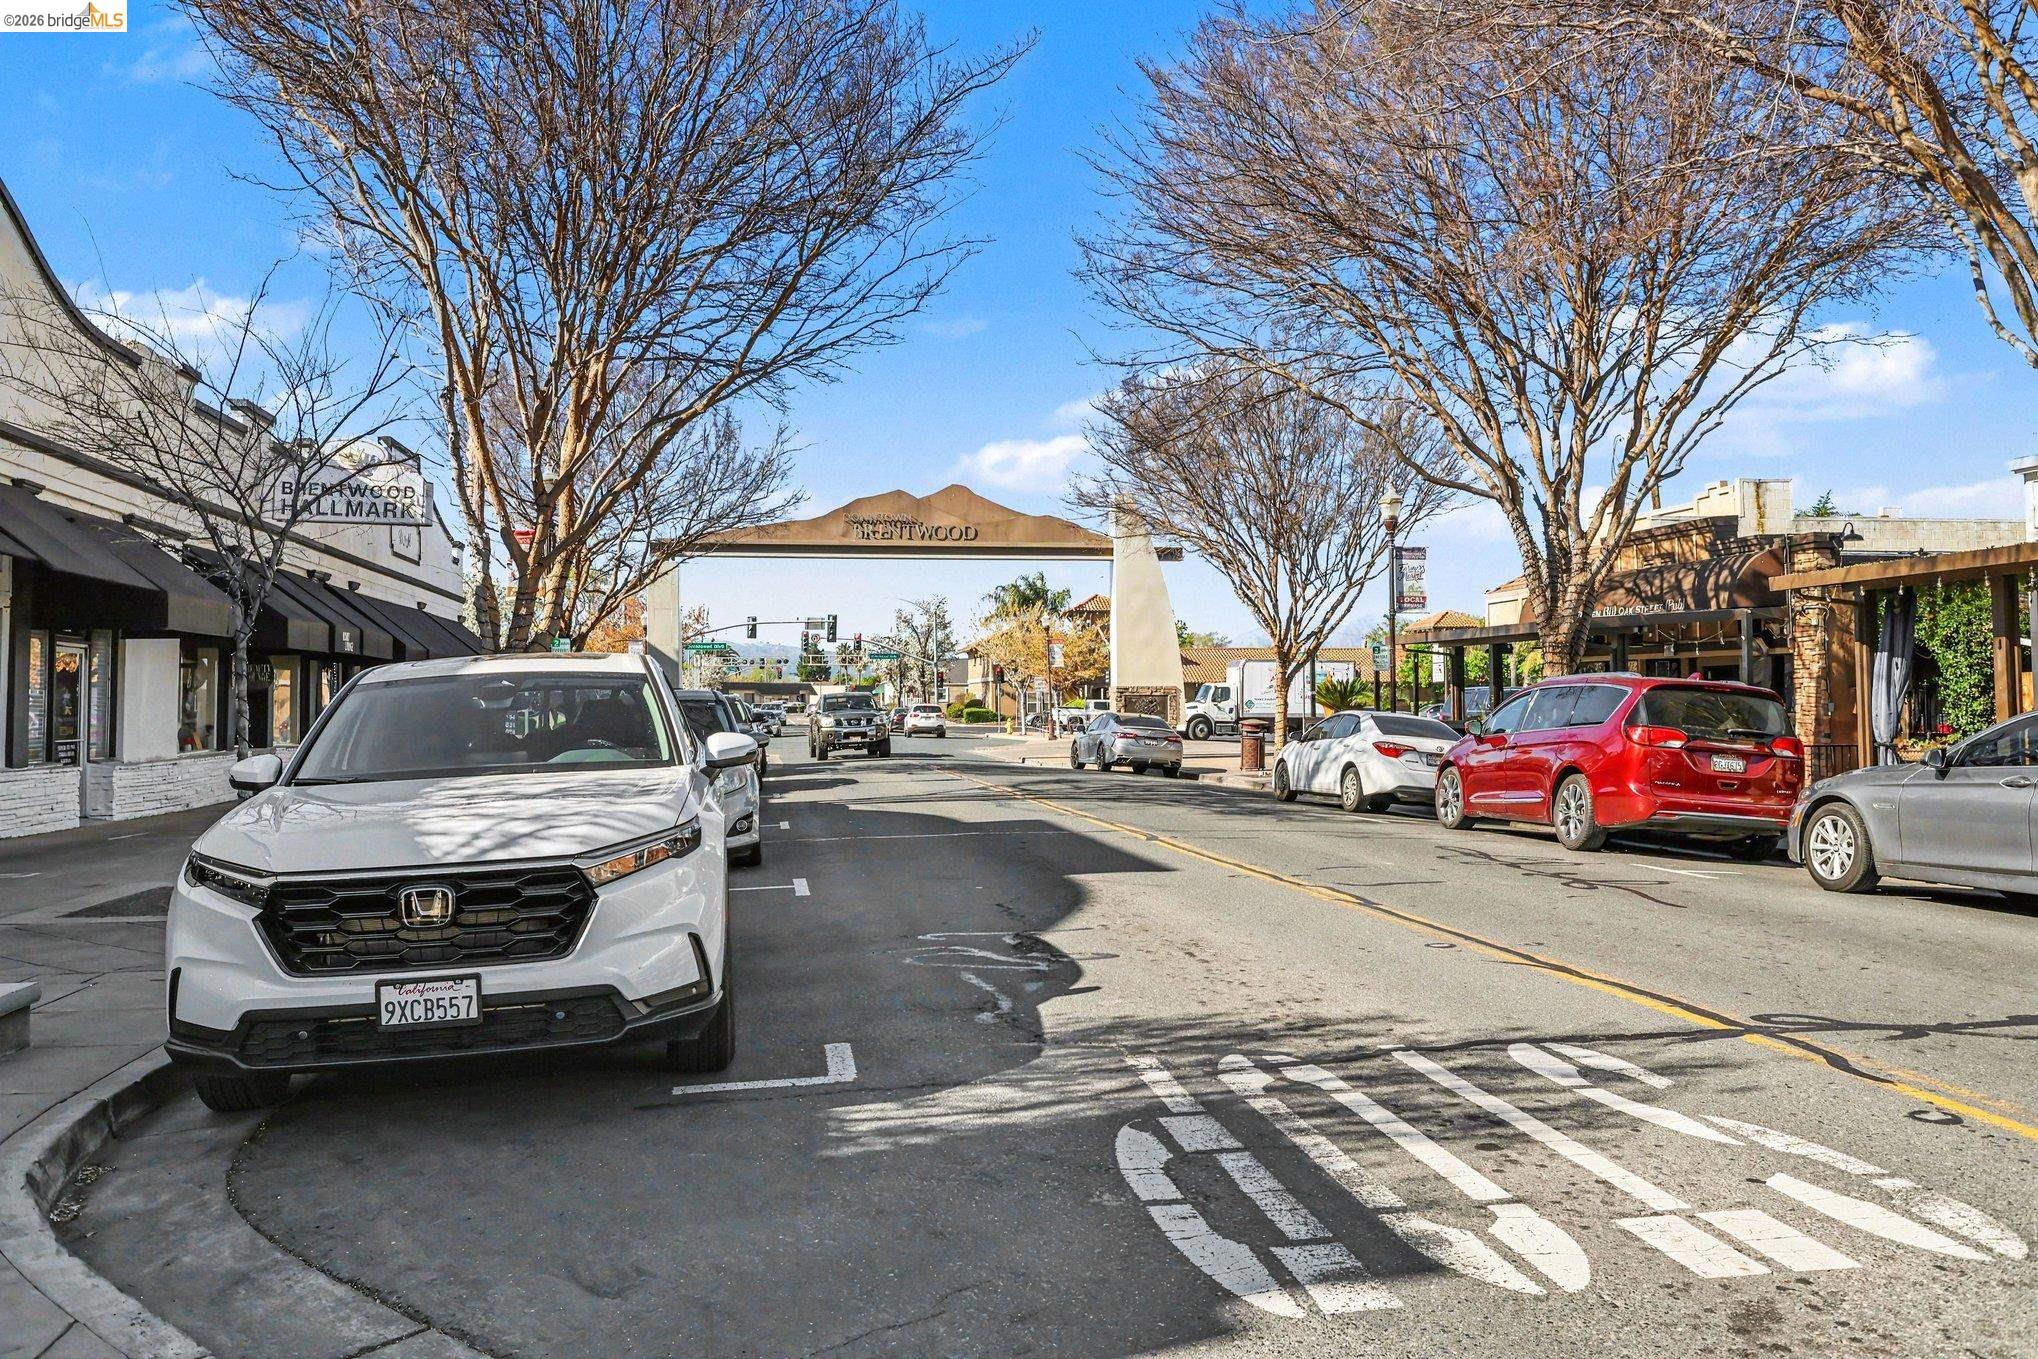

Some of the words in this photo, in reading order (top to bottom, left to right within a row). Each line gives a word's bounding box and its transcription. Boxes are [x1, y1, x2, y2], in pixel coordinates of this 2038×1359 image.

[852, 523, 979, 542] BRENTWOOD
[1618, 606, 1634, 616] OAK
[397, 982, 461, 998] California
[384, 994, 474, 1025] 9XCB557
